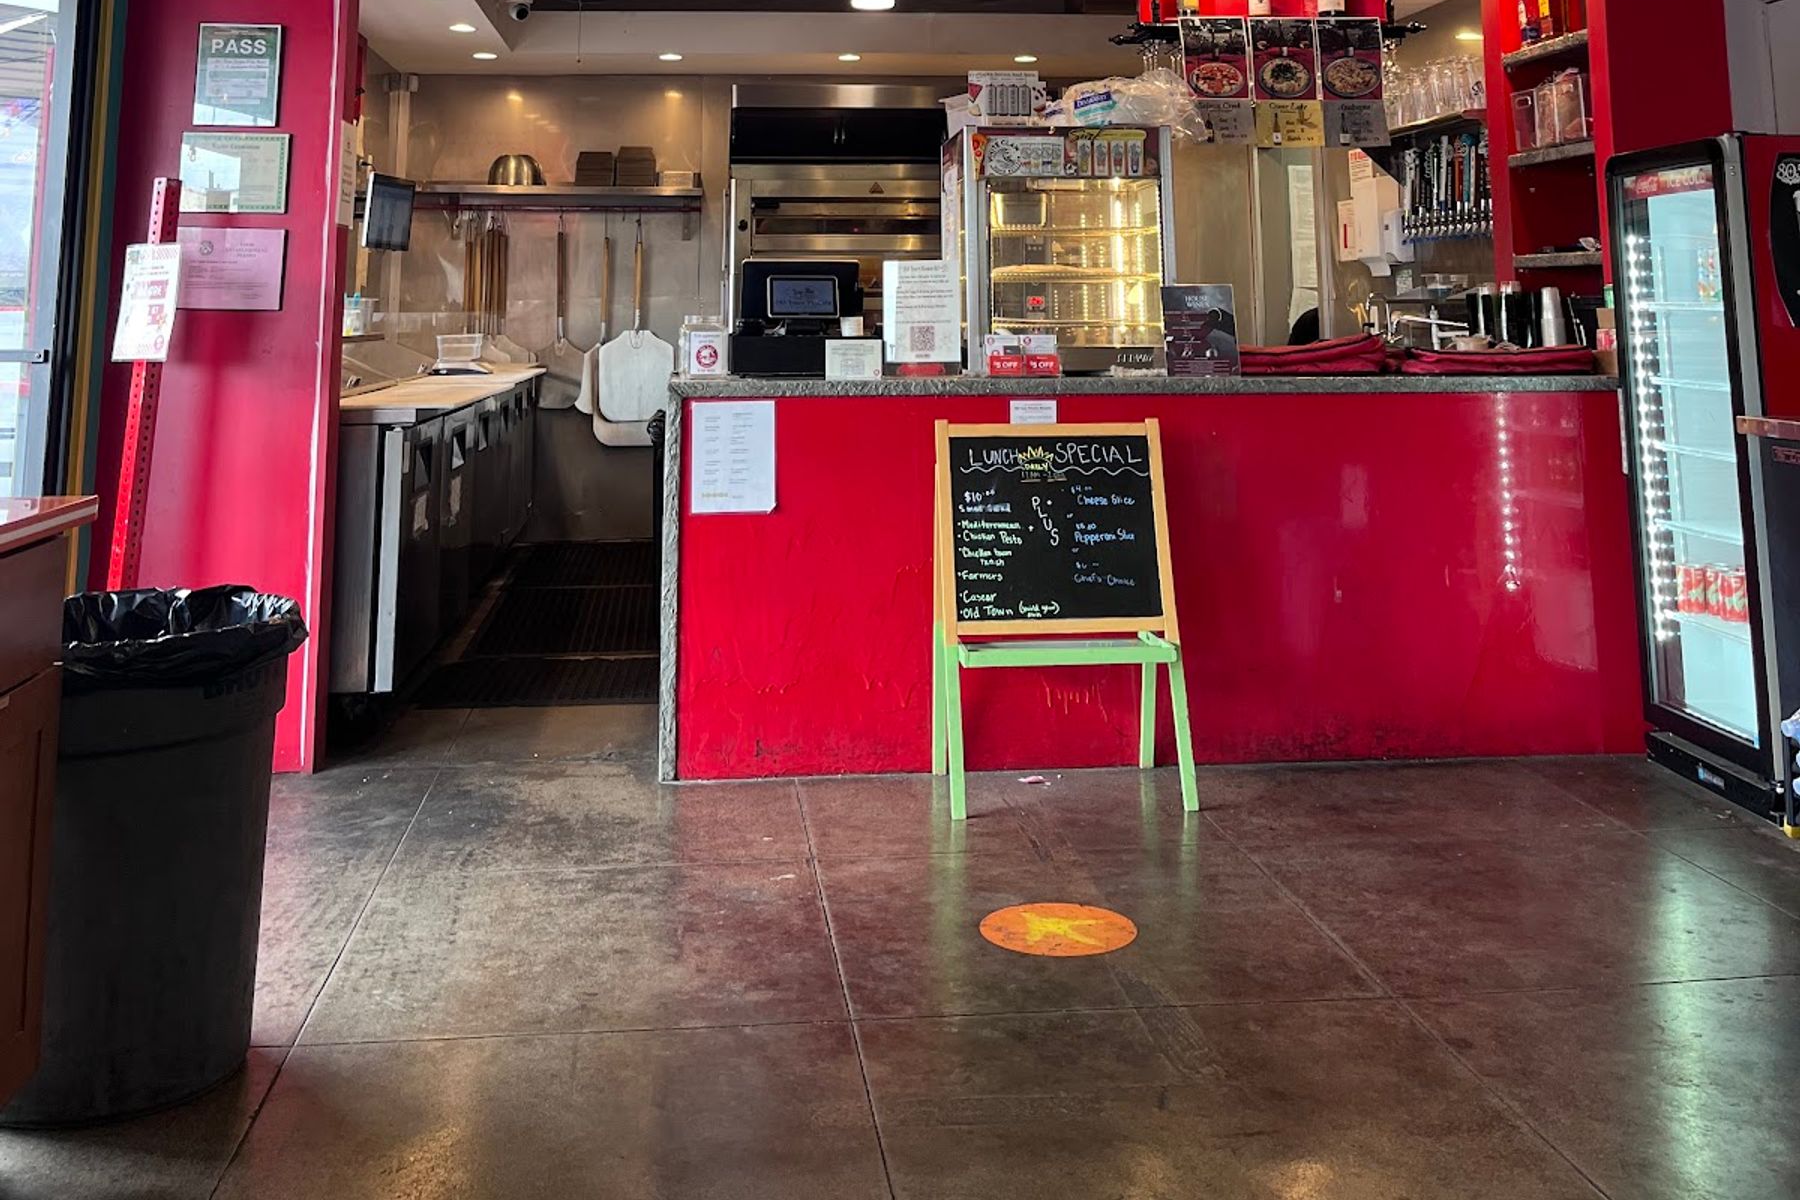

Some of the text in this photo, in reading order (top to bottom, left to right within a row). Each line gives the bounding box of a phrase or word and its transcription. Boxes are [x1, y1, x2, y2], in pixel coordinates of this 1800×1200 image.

[211, 39, 267, 54] PASS
[1776, 163, 1800, 179] 80
[1683, 173, 1706, 185] COLD
[969, 443, 1142, 466] LUNCH SPECIAL
[1024, 462, 1049, 471] DAILY
[1077, 495, 1108, 505] Cheese
[1001, 531, 1022, 544] Pesto
[963, 607, 1013, 619] Old Town
